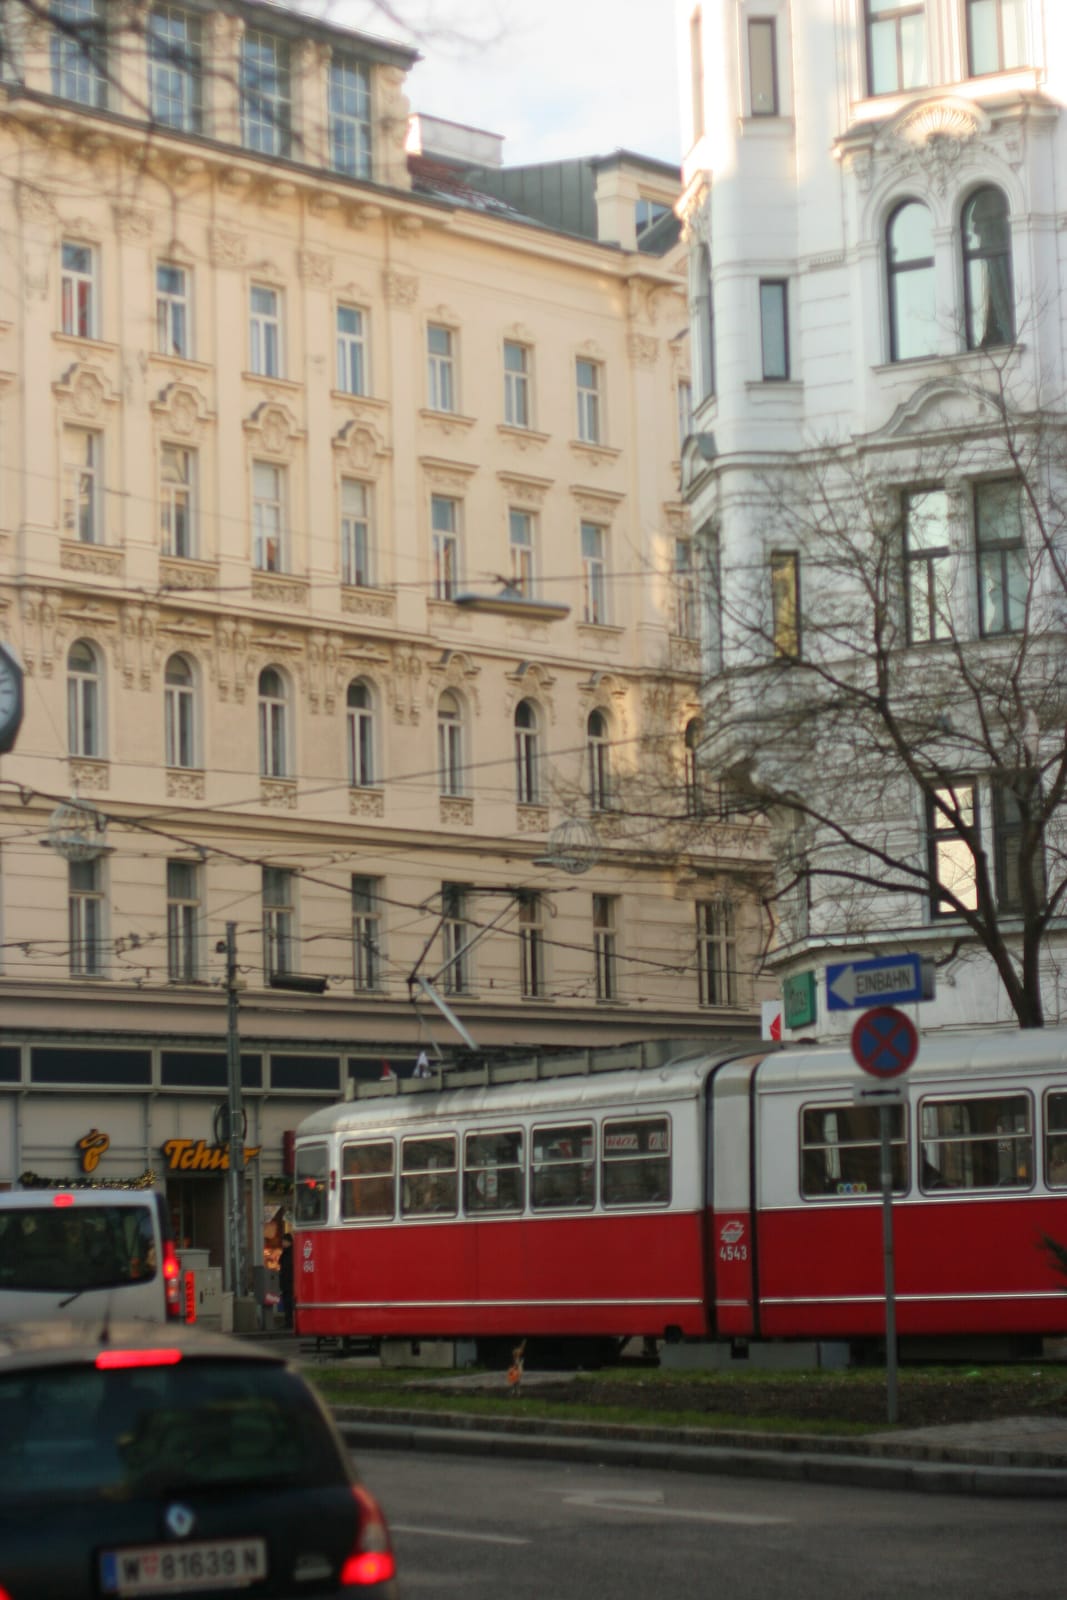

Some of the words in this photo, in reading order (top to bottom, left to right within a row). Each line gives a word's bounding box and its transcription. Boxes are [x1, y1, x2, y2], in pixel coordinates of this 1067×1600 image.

[856, 968, 911, 995] EINBAHN
[720, 1245, 748, 1261] 4543
[122, 1556, 141, 1583] W
[160, 1551, 236, 1581] 81639
[242, 1547, 259, 1570] N
